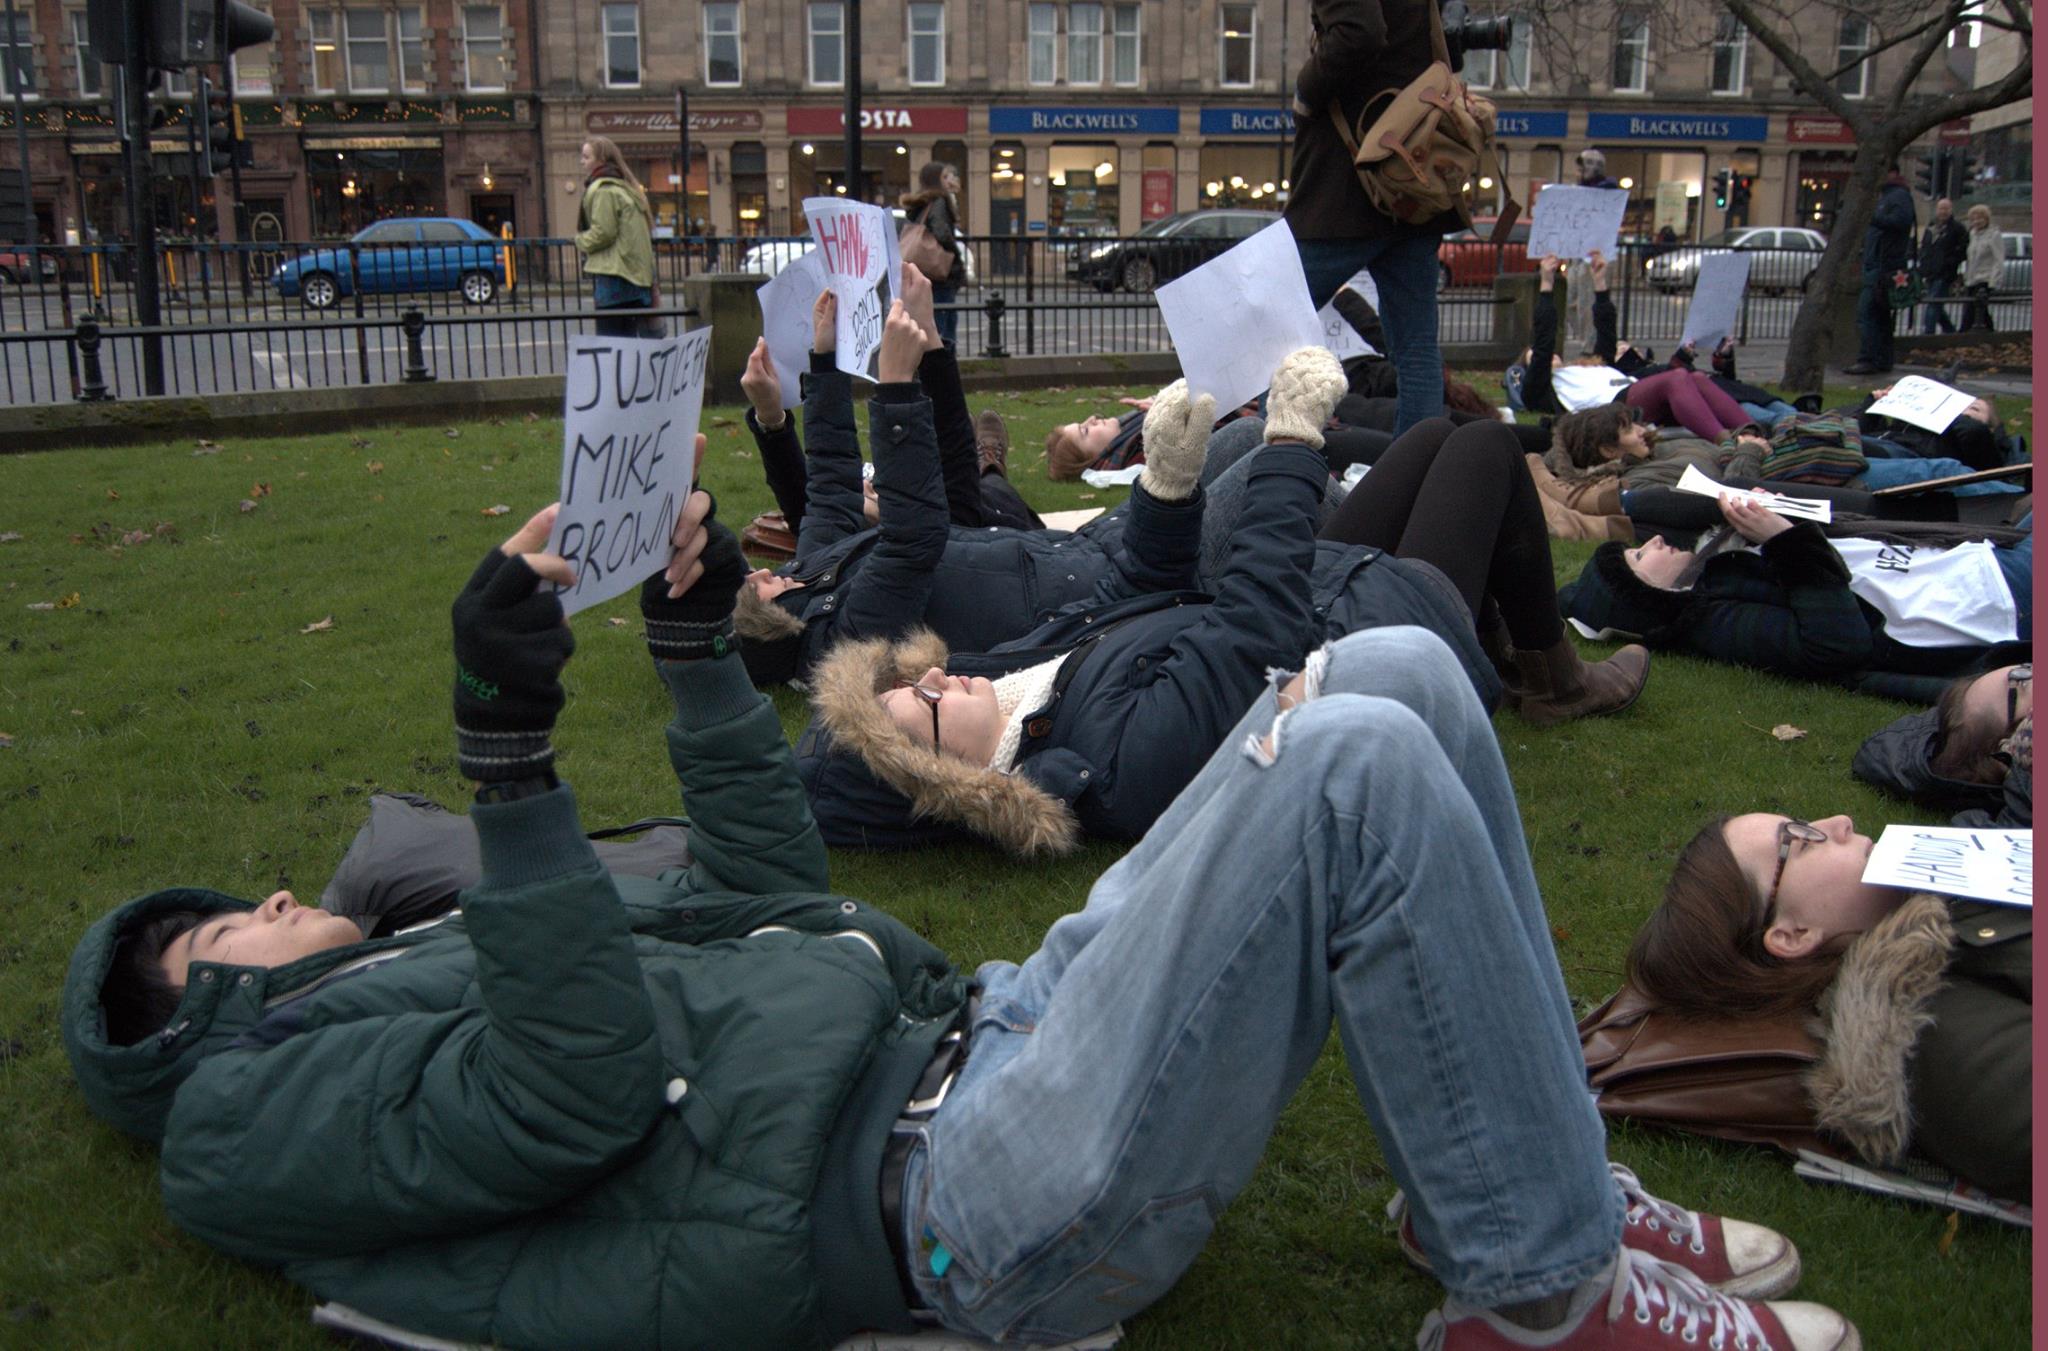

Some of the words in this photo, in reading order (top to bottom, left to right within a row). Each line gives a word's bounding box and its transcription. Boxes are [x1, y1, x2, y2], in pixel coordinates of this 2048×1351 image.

[840, 110, 912, 130] OSTA
[1032, 111, 1138, 129] BLACKWELL'S
[1630, 117, 1729, 136] BLACKWELL'S
[851, 286, 876, 337] DON'T
[855, 313, 880, 370] SHOOT
[573, 338, 695, 412] JUSTICE
[566, 420, 672, 506] MIKE
[552, 485, 689, 596] BROWN
